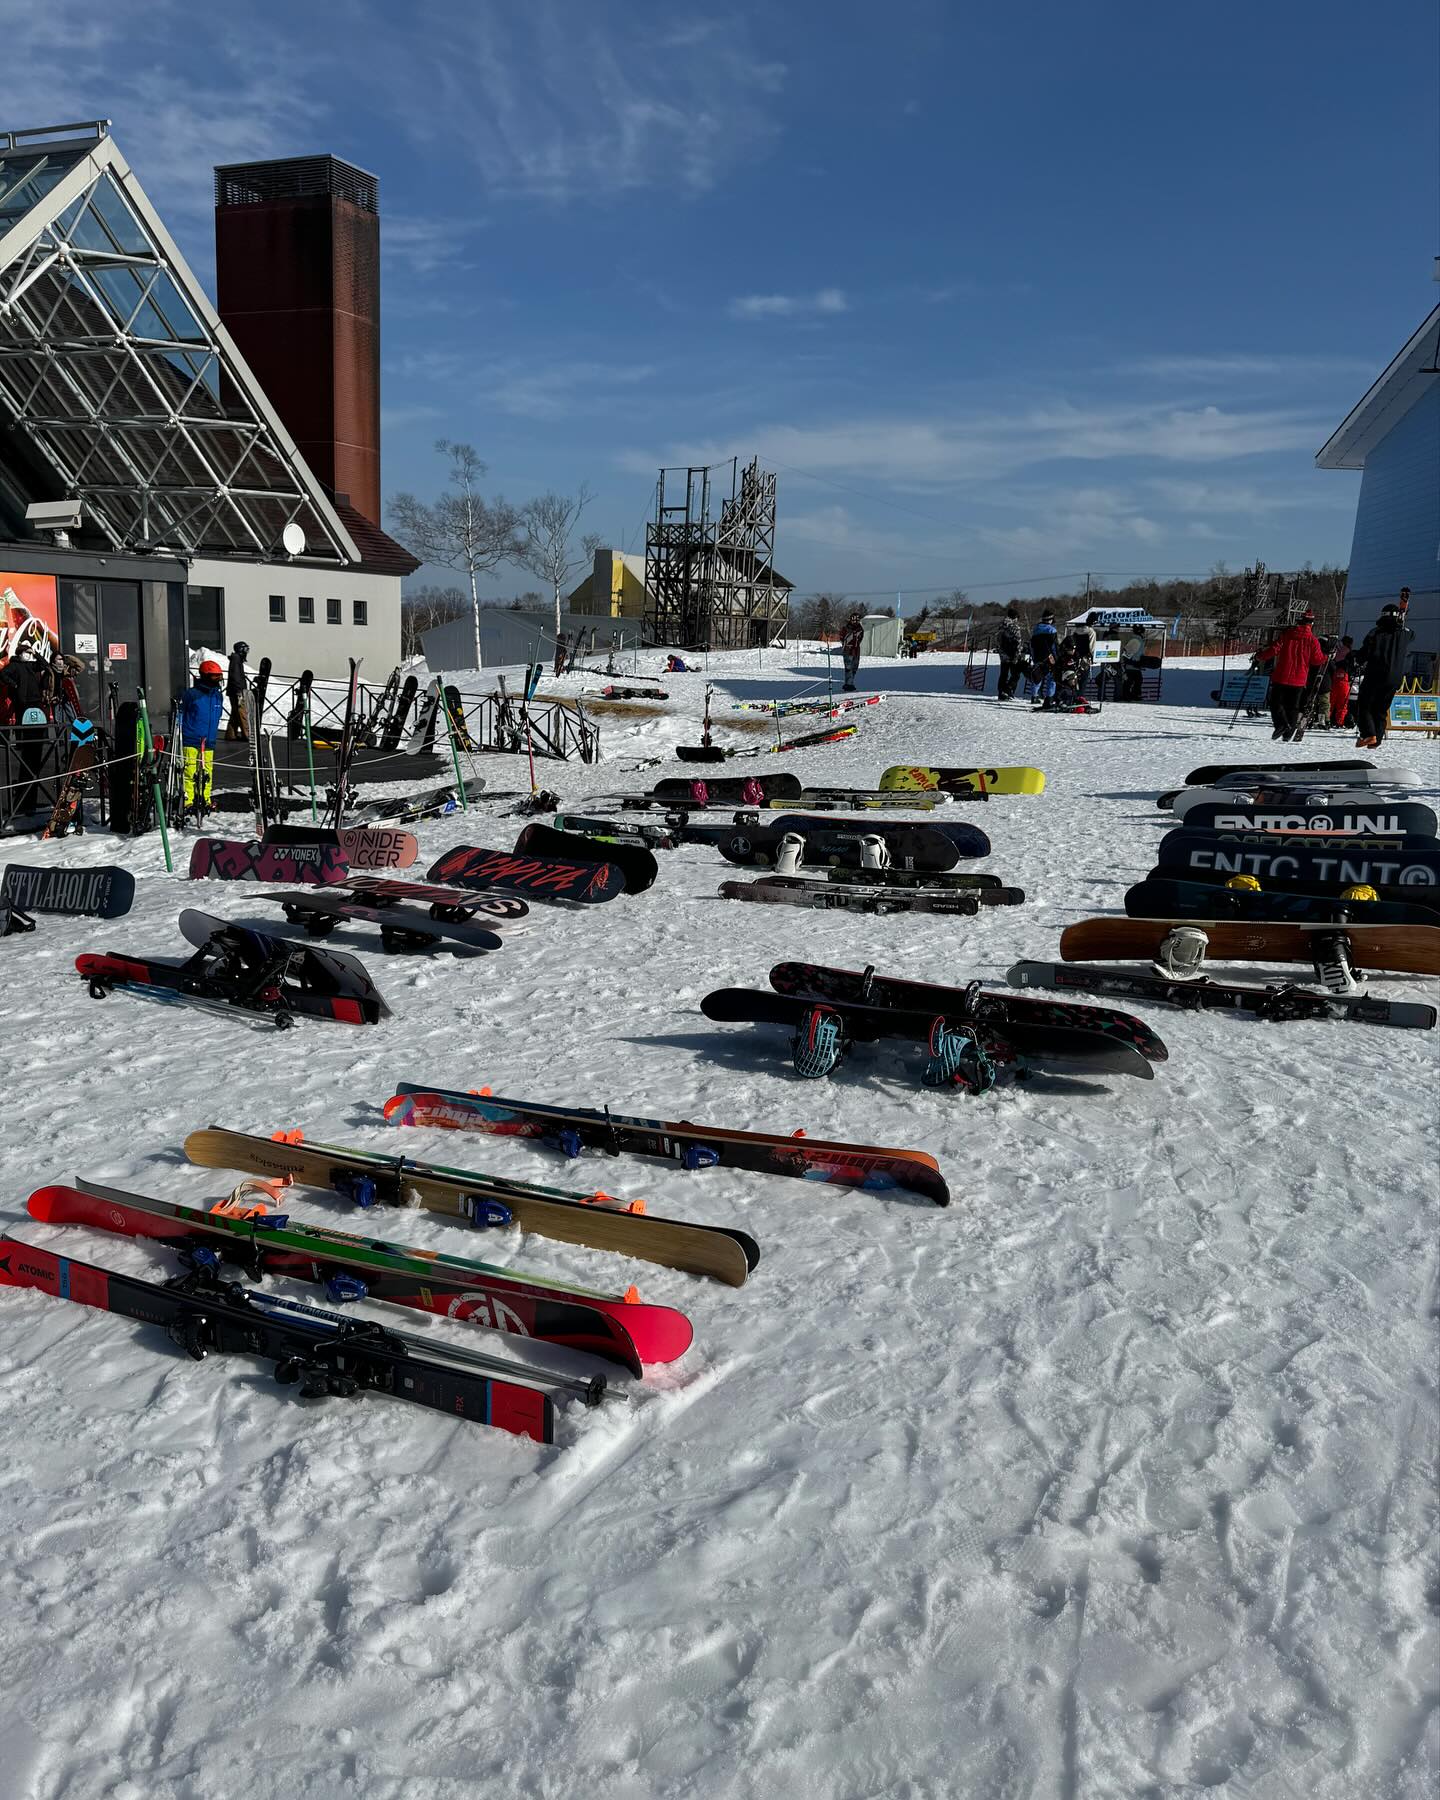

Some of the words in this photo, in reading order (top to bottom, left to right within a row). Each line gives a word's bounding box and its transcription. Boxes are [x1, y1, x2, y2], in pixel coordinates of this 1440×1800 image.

[361, 832, 404, 849] NIDE
[290, 848, 318, 862] YONEX
[6, 871, 105, 911] STYLAHOLIC
[1323, 963, 1350, 994] FLUX
[17, 1263, 55, 1281] ATOMIC
